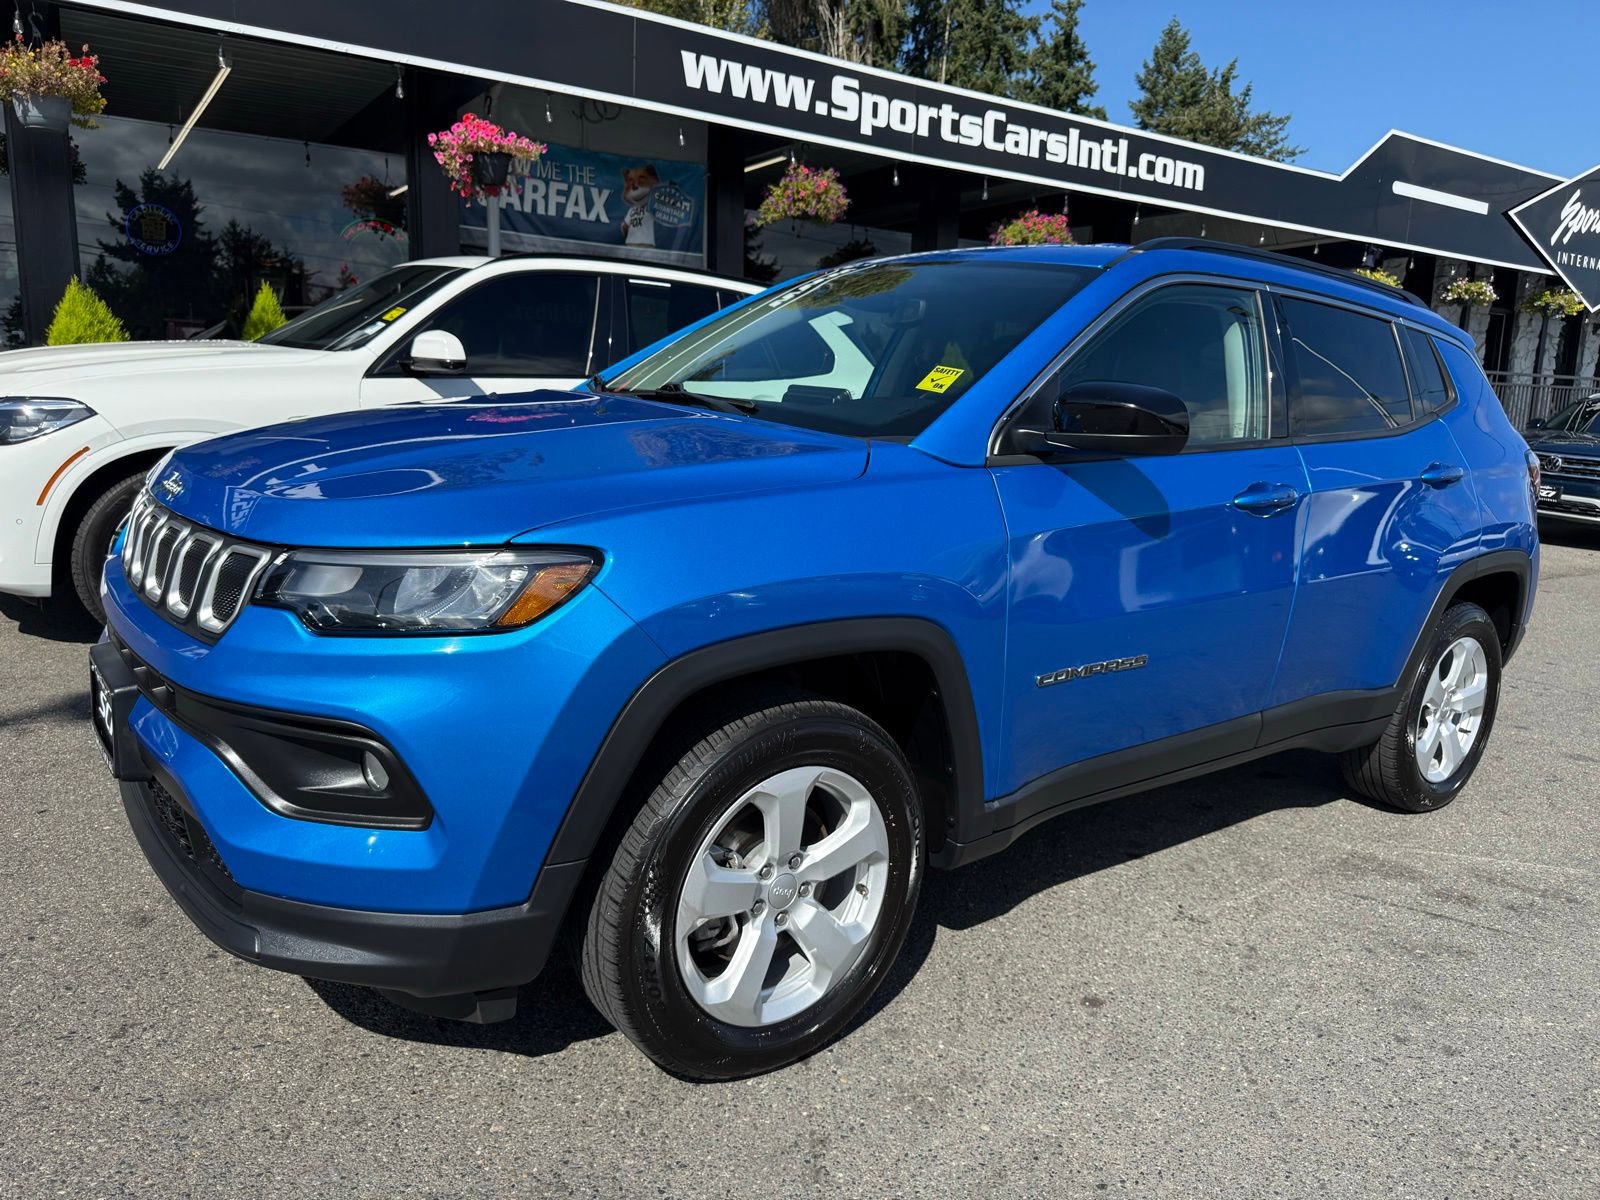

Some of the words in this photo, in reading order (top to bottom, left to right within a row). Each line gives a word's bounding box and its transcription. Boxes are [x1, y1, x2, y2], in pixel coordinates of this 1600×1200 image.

[680, 50, 1205, 191] www.SportsCarsIntl.com
[536, 160, 562, 181] ME
[565, 163, 596, 186] THE
[630, 217, 643, 228] FOX
[933, 367, 962, 377] SAFETY
[1035, 654, 1148, 688] COMPASS
